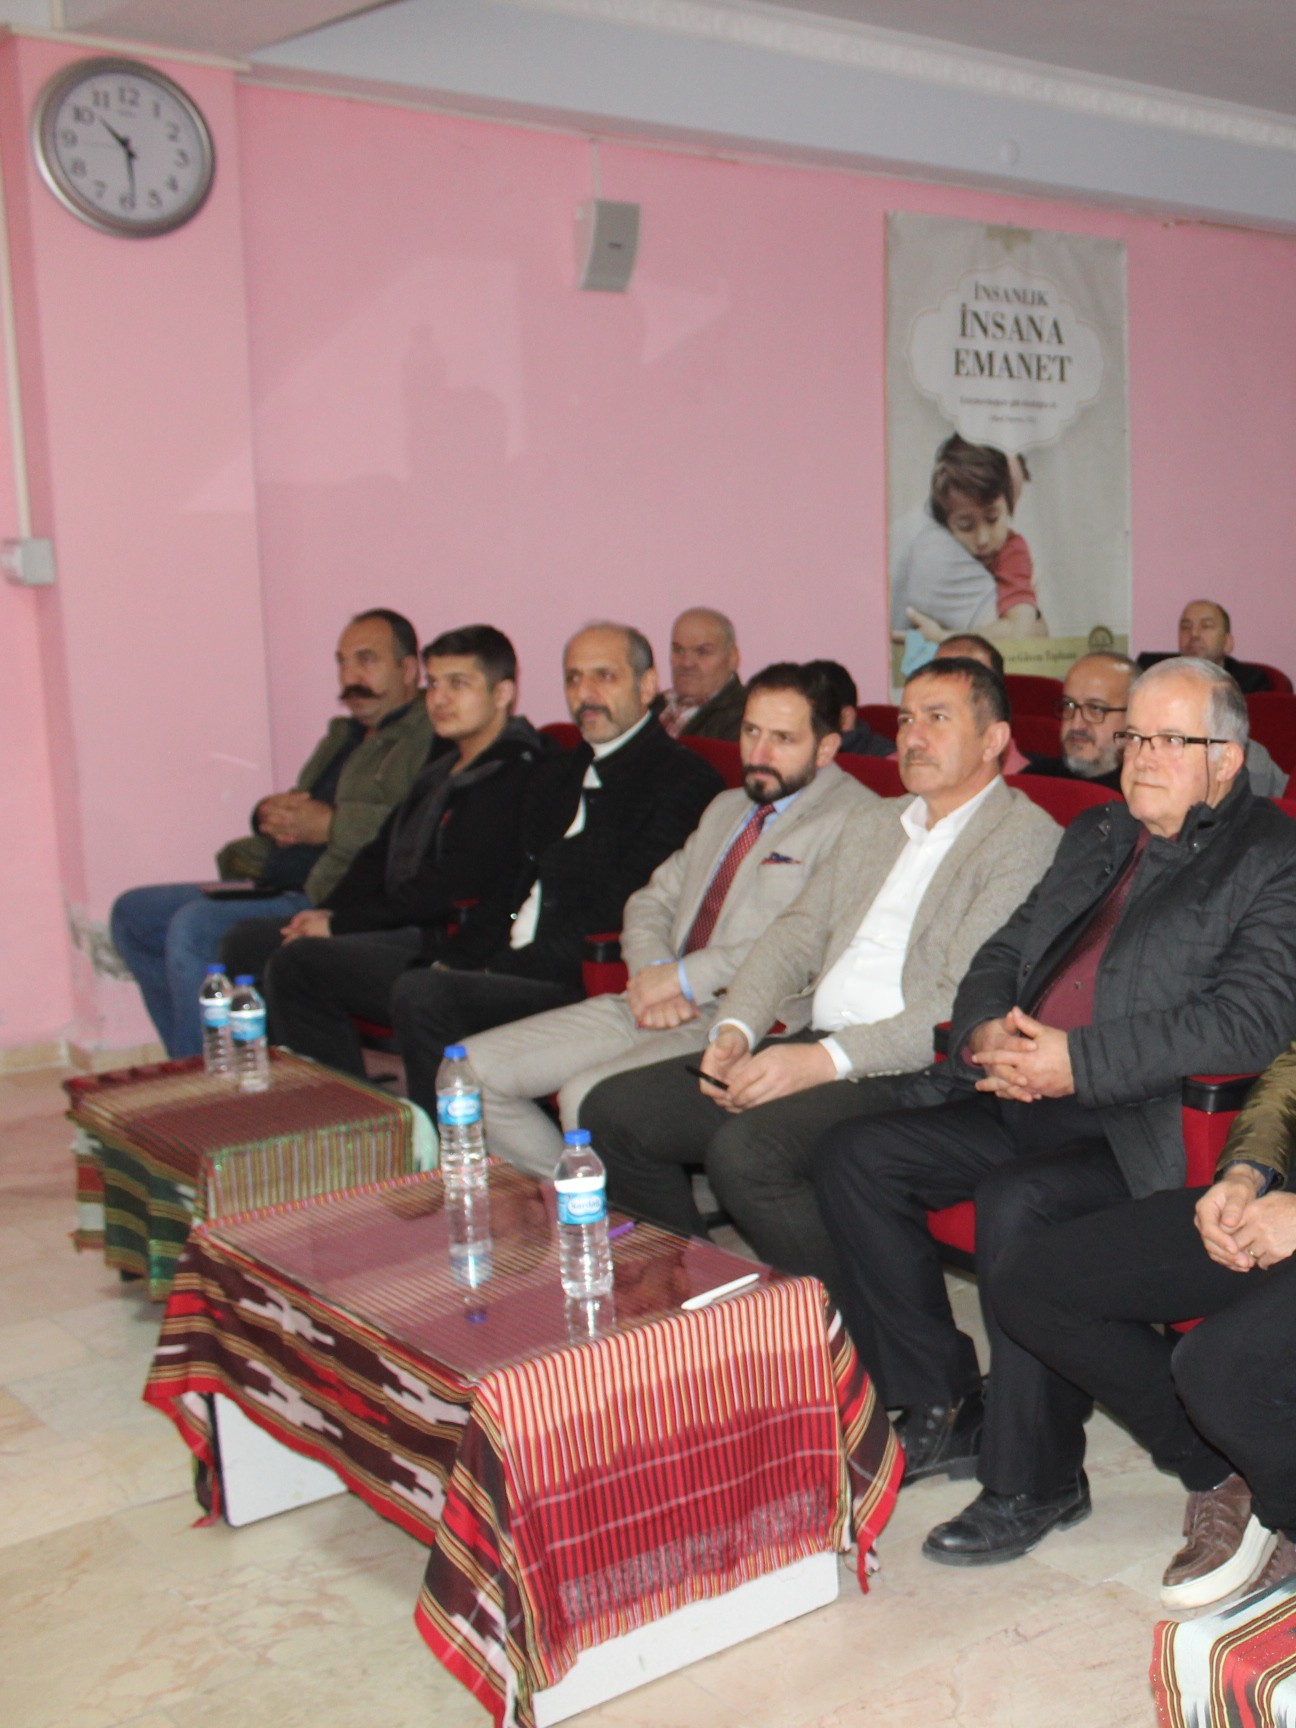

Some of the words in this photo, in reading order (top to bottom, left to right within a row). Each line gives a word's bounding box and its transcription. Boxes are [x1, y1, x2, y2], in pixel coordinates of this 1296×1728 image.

[92, 90, 110, 109] 11
[119, 87, 140, 107] 12
[73, 105, 95, 126] 10
[153, 102, 161, 118] 1
[61, 129, 77, 147] 9
[167, 121, 179, 142] 2
[71, 157, 87, 177] 8
[174, 149, 189, 168] 3
[94, 180, 108, 198] 7
[166, 176, 178, 192] 4
[119, 193, 136, 210] 6
[148, 189, 163, 208] 5
[974, 280, 1049, 307] İNSANLIK
[959, 301, 1065, 345] İNSANA
[953, 348, 1073, 383] EMANET
